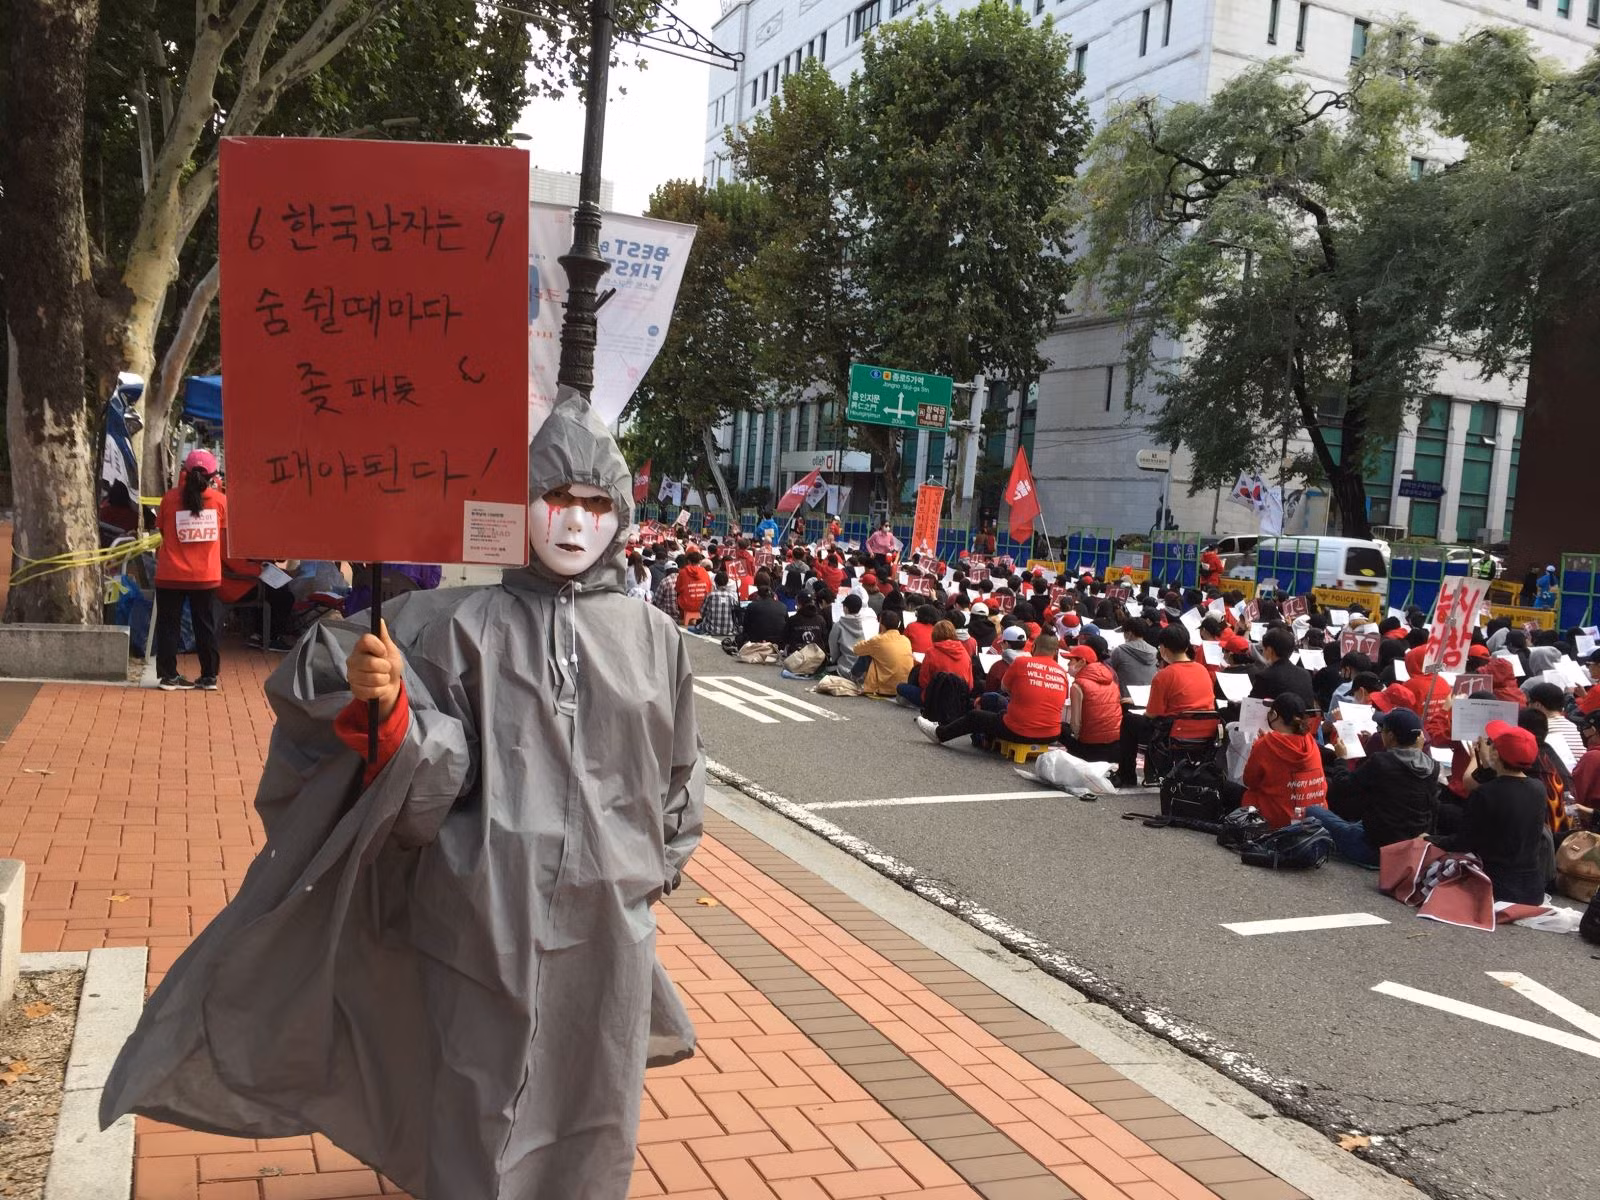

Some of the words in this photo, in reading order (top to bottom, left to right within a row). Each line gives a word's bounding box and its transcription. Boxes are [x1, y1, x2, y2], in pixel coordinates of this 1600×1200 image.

[281, 203, 466, 252] 한국남자는
[256, 287, 289, 336] 숨
[892, 373, 925, 386] 종로5가역
[852, 391, 880, 404] 흥인지문
[178, 527, 217, 541] STAFF
[1331, 593, 1354, 603] POLICE
[1027, 670, 1044, 679] WILL
[1029, 679, 1043, 687] THE
[1290, 793, 1305, 801] WILL
